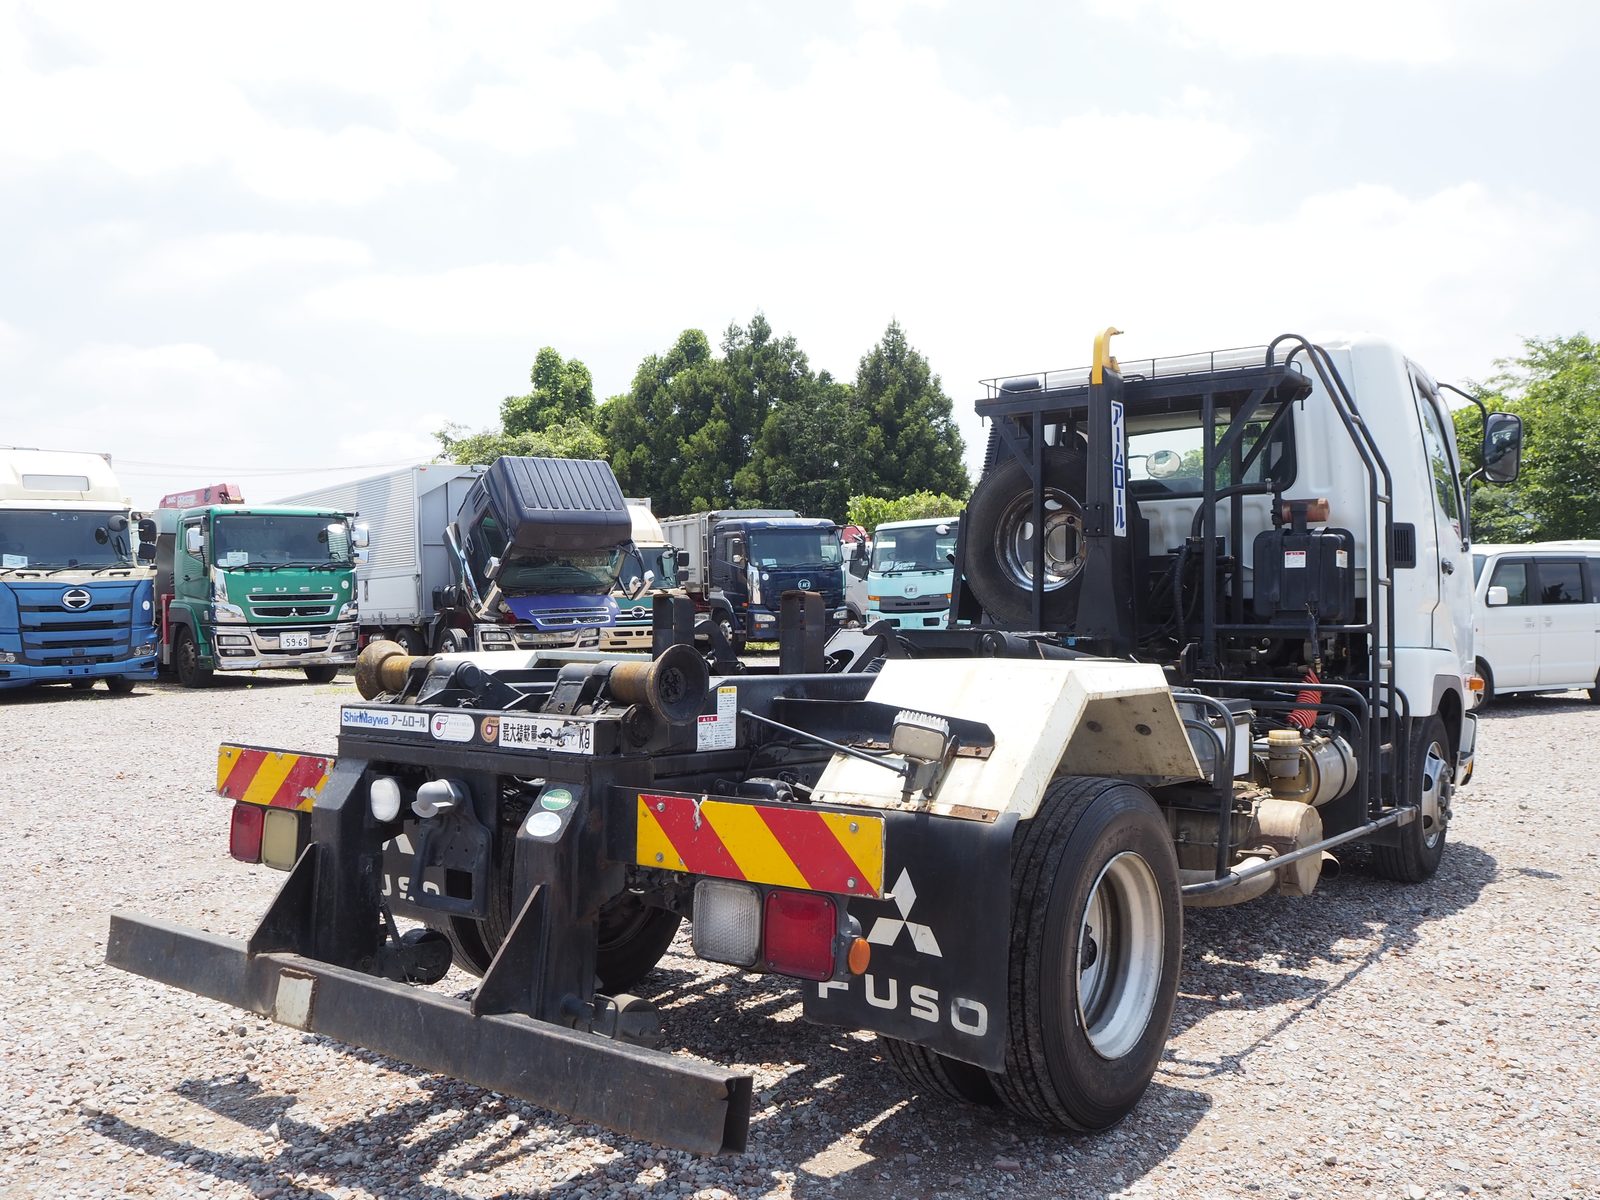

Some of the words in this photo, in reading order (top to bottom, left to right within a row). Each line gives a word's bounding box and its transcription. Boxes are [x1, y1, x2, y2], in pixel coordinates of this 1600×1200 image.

[1112, 402, 1125, 529] アームロール
[344, 711, 389, 727] ShinMaywa
[391, 714, 426, 728] アームロール
